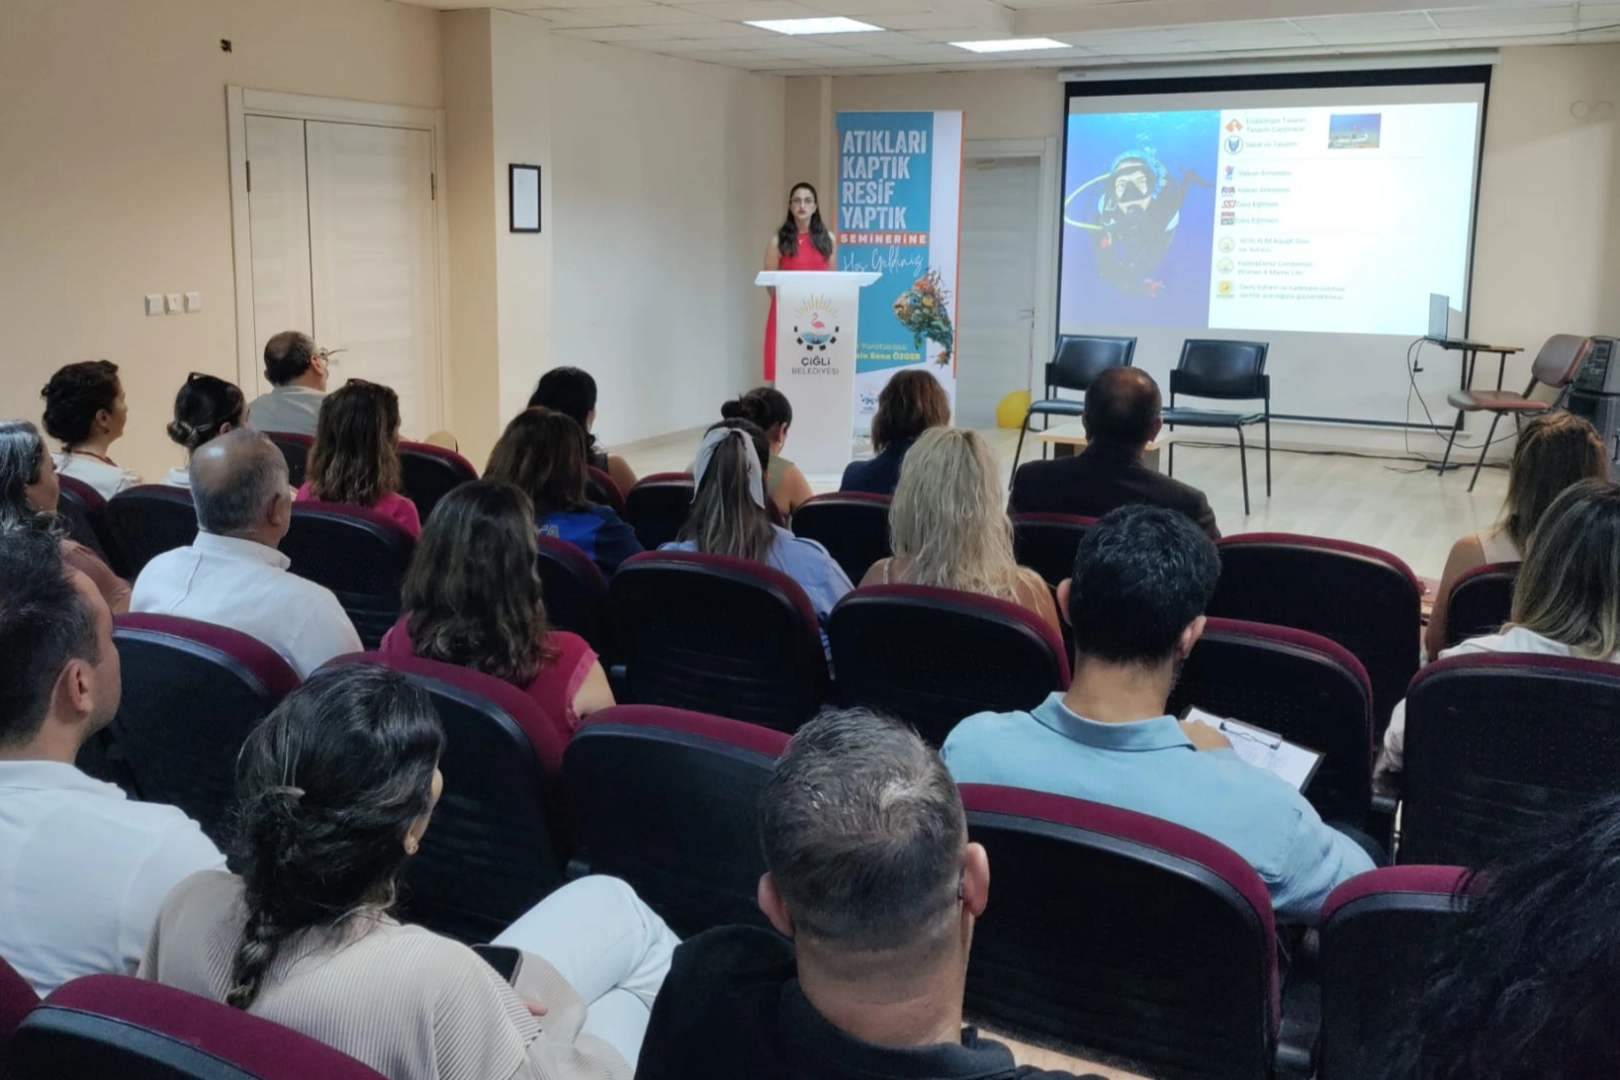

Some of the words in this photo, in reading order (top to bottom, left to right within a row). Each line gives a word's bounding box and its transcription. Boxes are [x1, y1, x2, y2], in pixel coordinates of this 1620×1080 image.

[843, 130, 927, 153] ATIKLARI
[843, 156, 910, 179] KAPTIK
[842, 179, 895, 204] RESİF
[842, 206, 907, 229] YAPTIK
[841, 233, 927, 244] SEMİNERİNE
